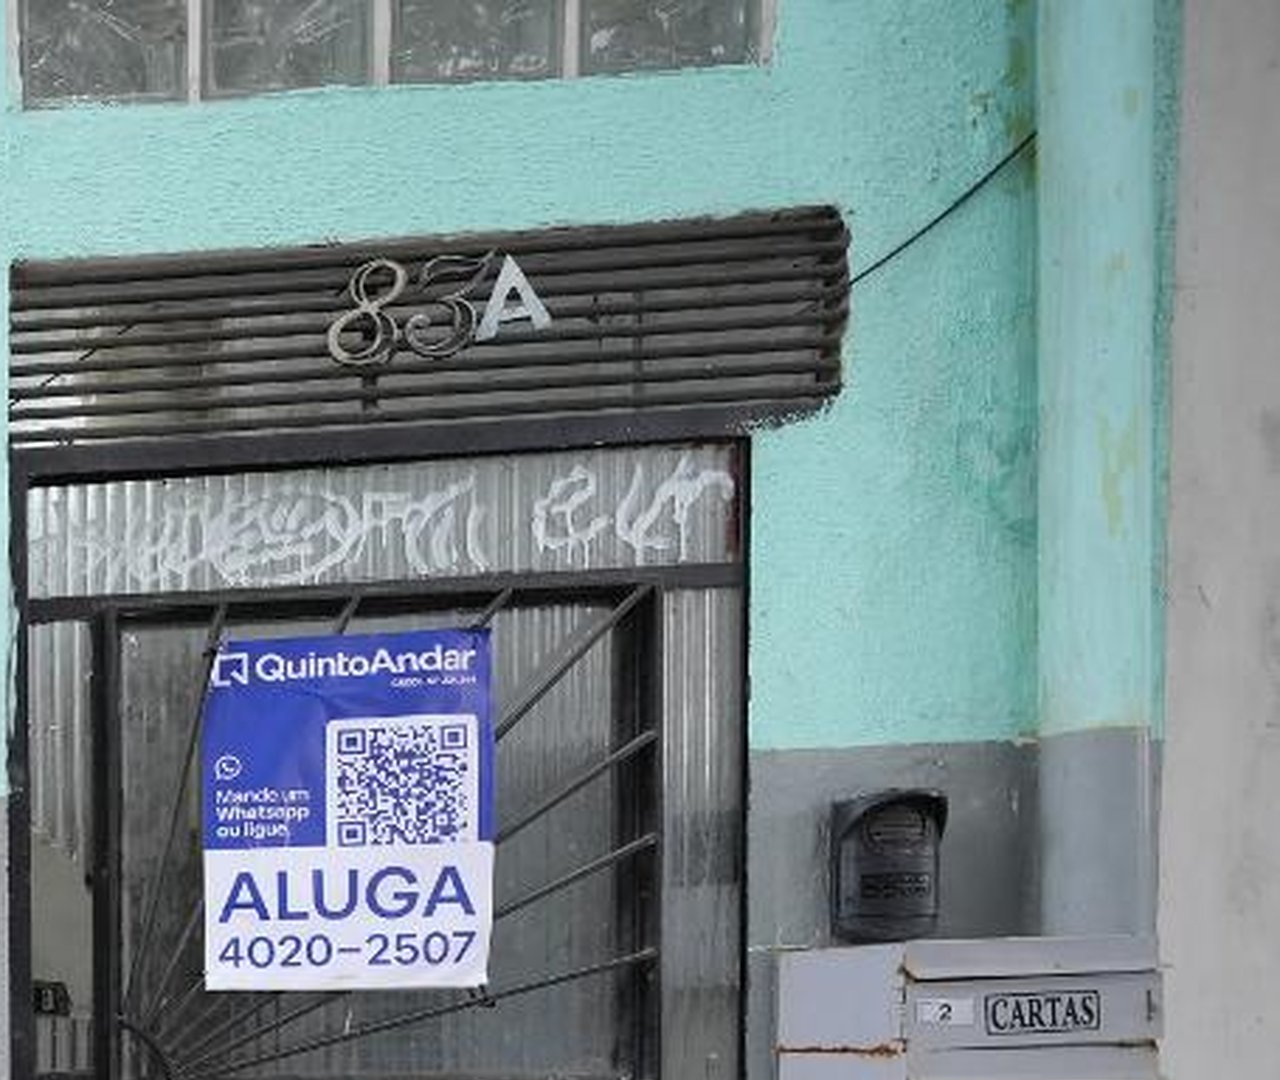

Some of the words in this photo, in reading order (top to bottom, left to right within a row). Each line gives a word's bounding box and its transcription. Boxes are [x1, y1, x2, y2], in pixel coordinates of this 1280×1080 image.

[255, 645, 477, 682] QuintoAndar
[216, 787, 279, 804] Mande
[216, 806, 311, 822] Whatsapp
[216, 825, 240, 838] ou
[218, 866, 477, 923] ALUGA
[218, 931, 477, 968] 4020-2507
[938, 1003, 953, 1021] 2
[991, 996, 1096, 1030] CARTAS
